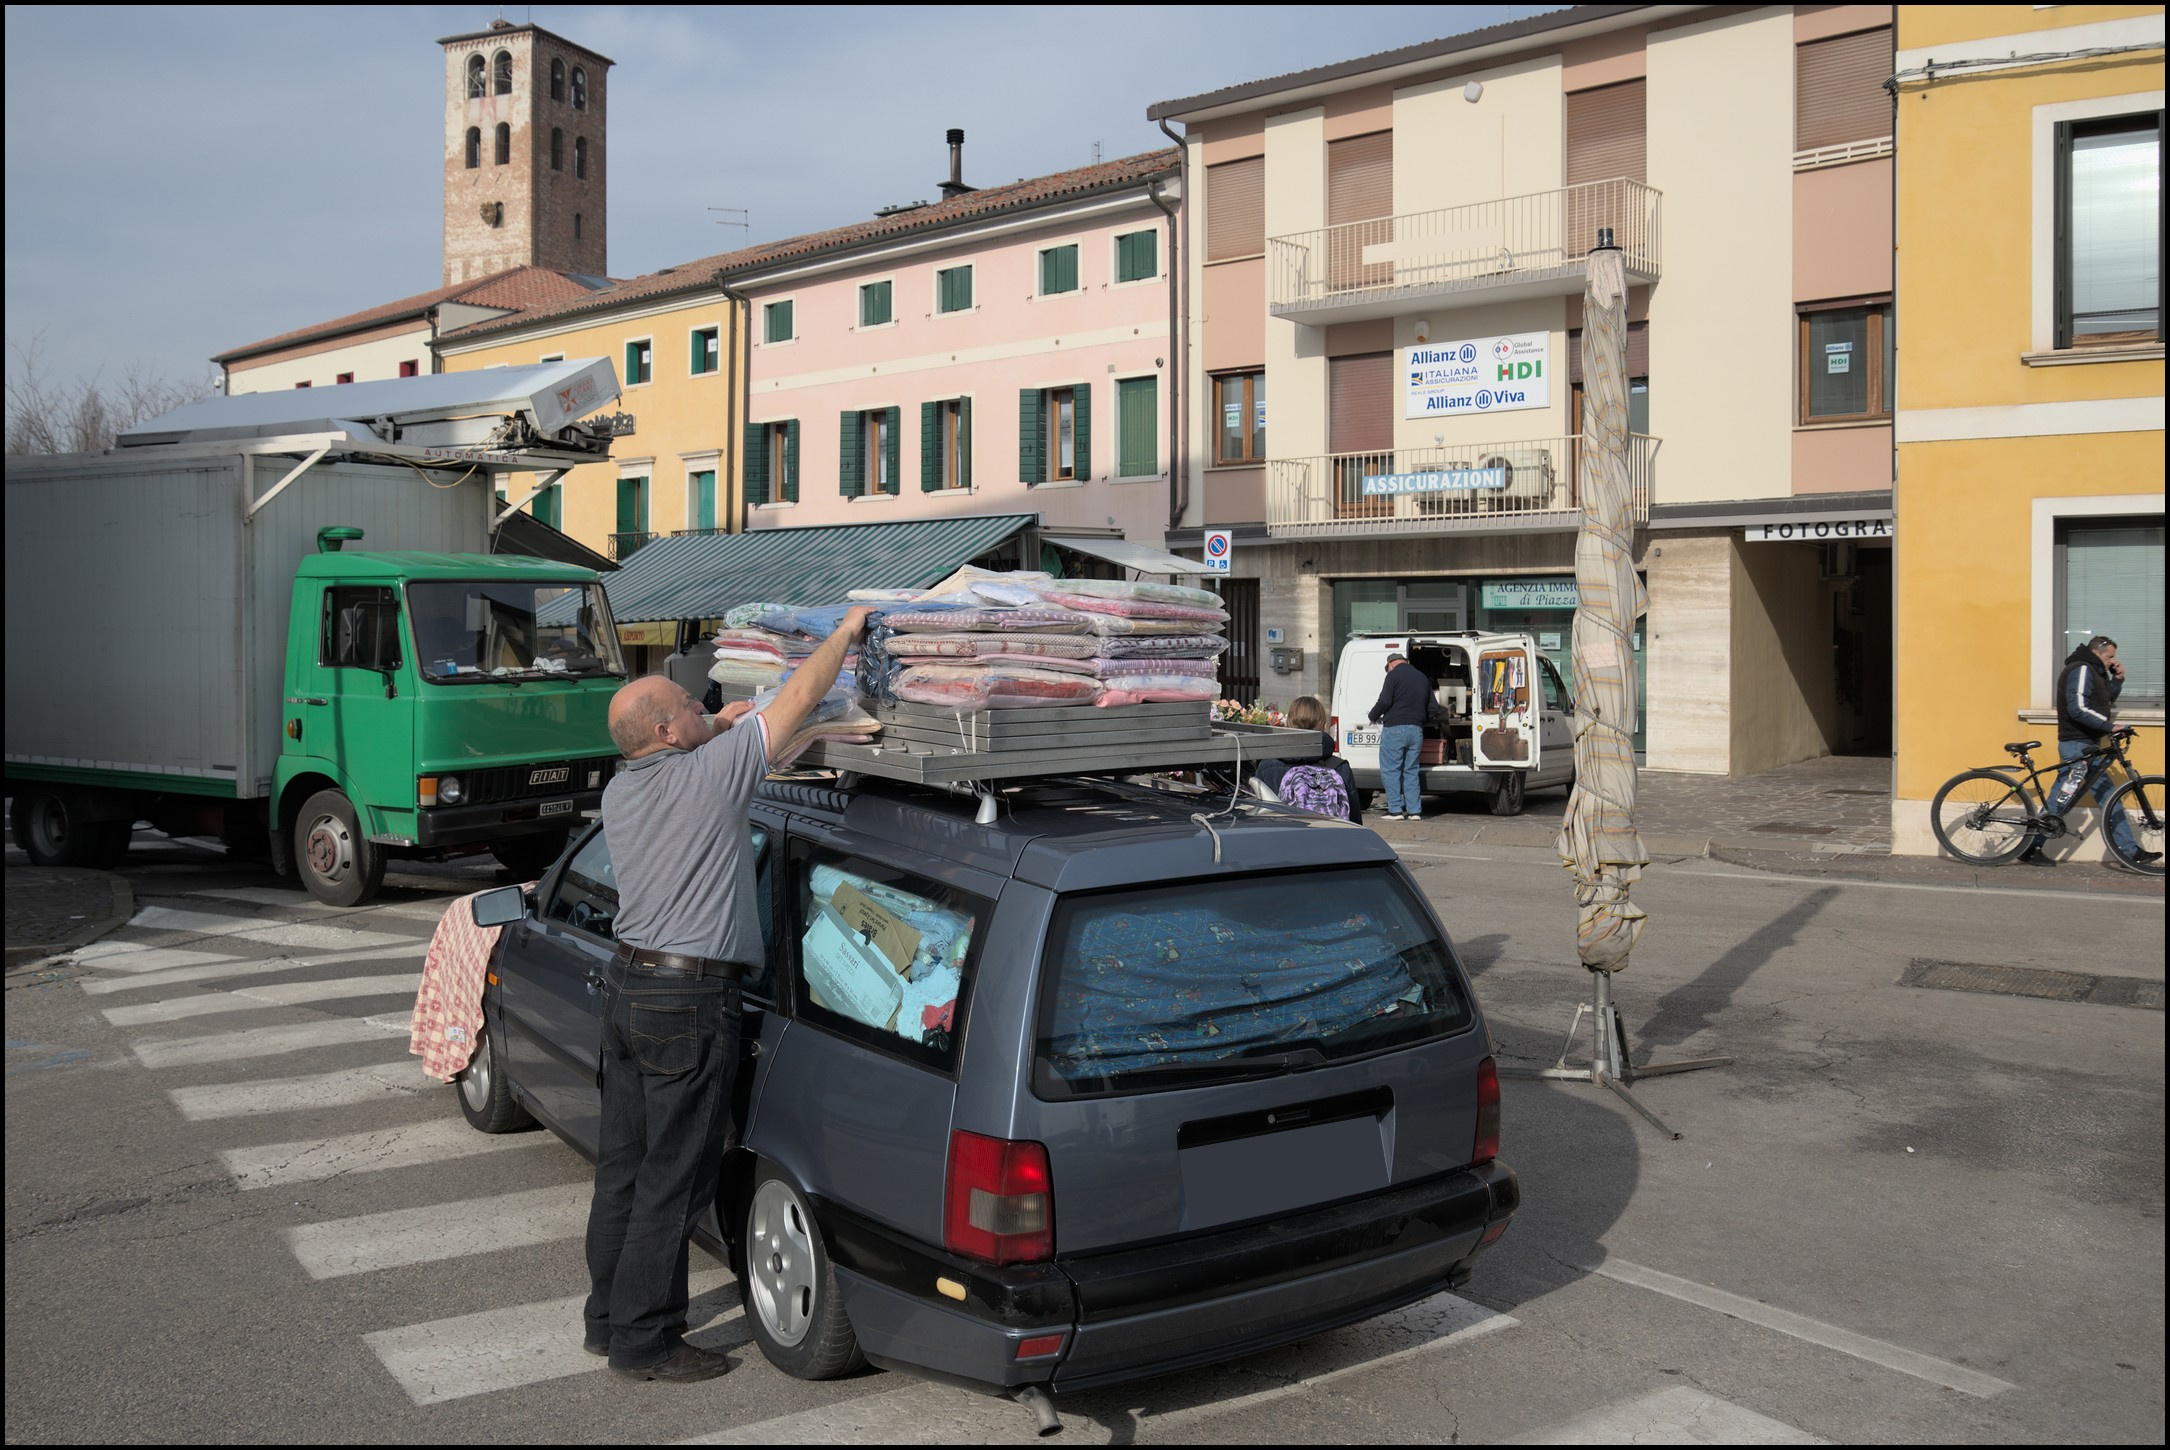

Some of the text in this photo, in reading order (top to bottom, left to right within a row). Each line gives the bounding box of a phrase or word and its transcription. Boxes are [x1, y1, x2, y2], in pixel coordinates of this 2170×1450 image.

[1514, 341, 1533, 349] Global
[1514, 347, 1544, 355] Assistance
[1411, 351, 1456, 365] Allianz
[1830, 358, 1847, 366] HDI
[1425, 366, 1478, 379] ITALIANA
[1498, 360, 1542, 382] HDI
[1424, 375, 1479, 386] ASSICURAZIONI
[1427, 390, 1525, 410] Allianz Viva
[424, 449, 519, 464] AUTOMATICA
[1365, 469, 1502, 494] ASSICURAZIONI
[1764, 519, 1892, 539] FOTOGRA
[1497, 582, 1546, 593] AGENZIA
[1520, 593, 1577, 606] di Piazza
[1353, 733, 1364, 744] EB
[531, 769, 568, 784] FIAT
[839, 942, 861, 969] Sassari
